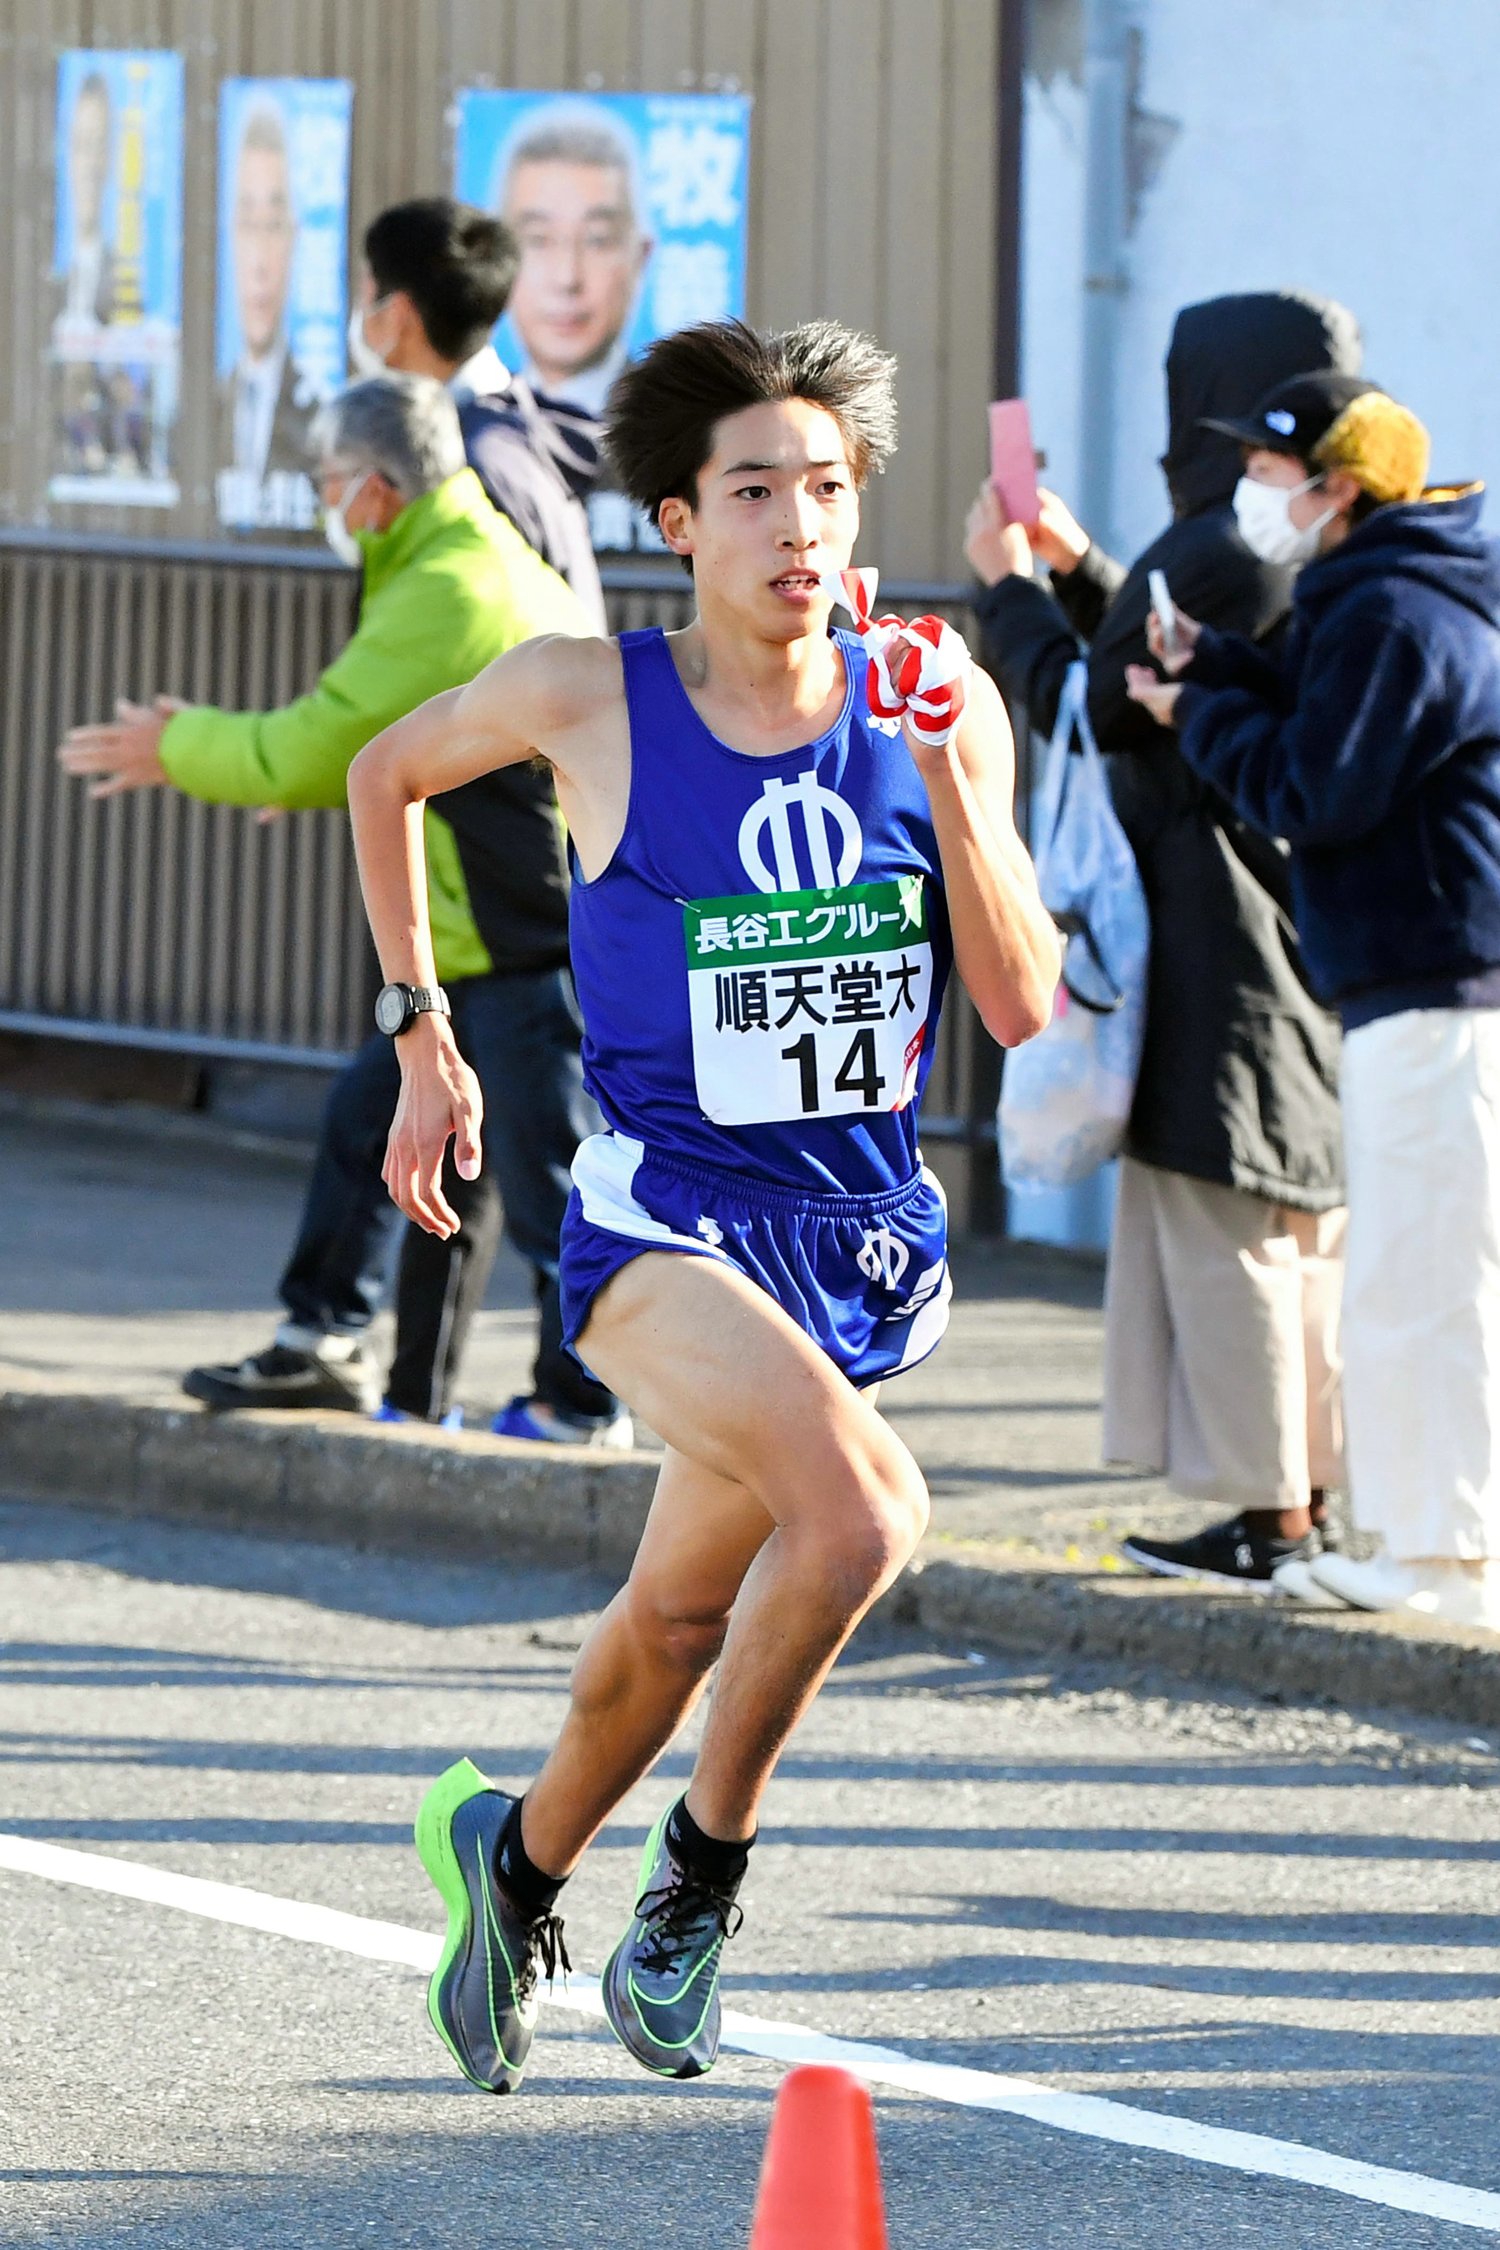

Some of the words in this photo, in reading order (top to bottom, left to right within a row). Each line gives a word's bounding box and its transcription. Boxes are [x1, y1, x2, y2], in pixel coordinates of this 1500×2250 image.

[715, 953, 921, 1034] 順天堂大
[781, 1028, 886, 1113] 14
